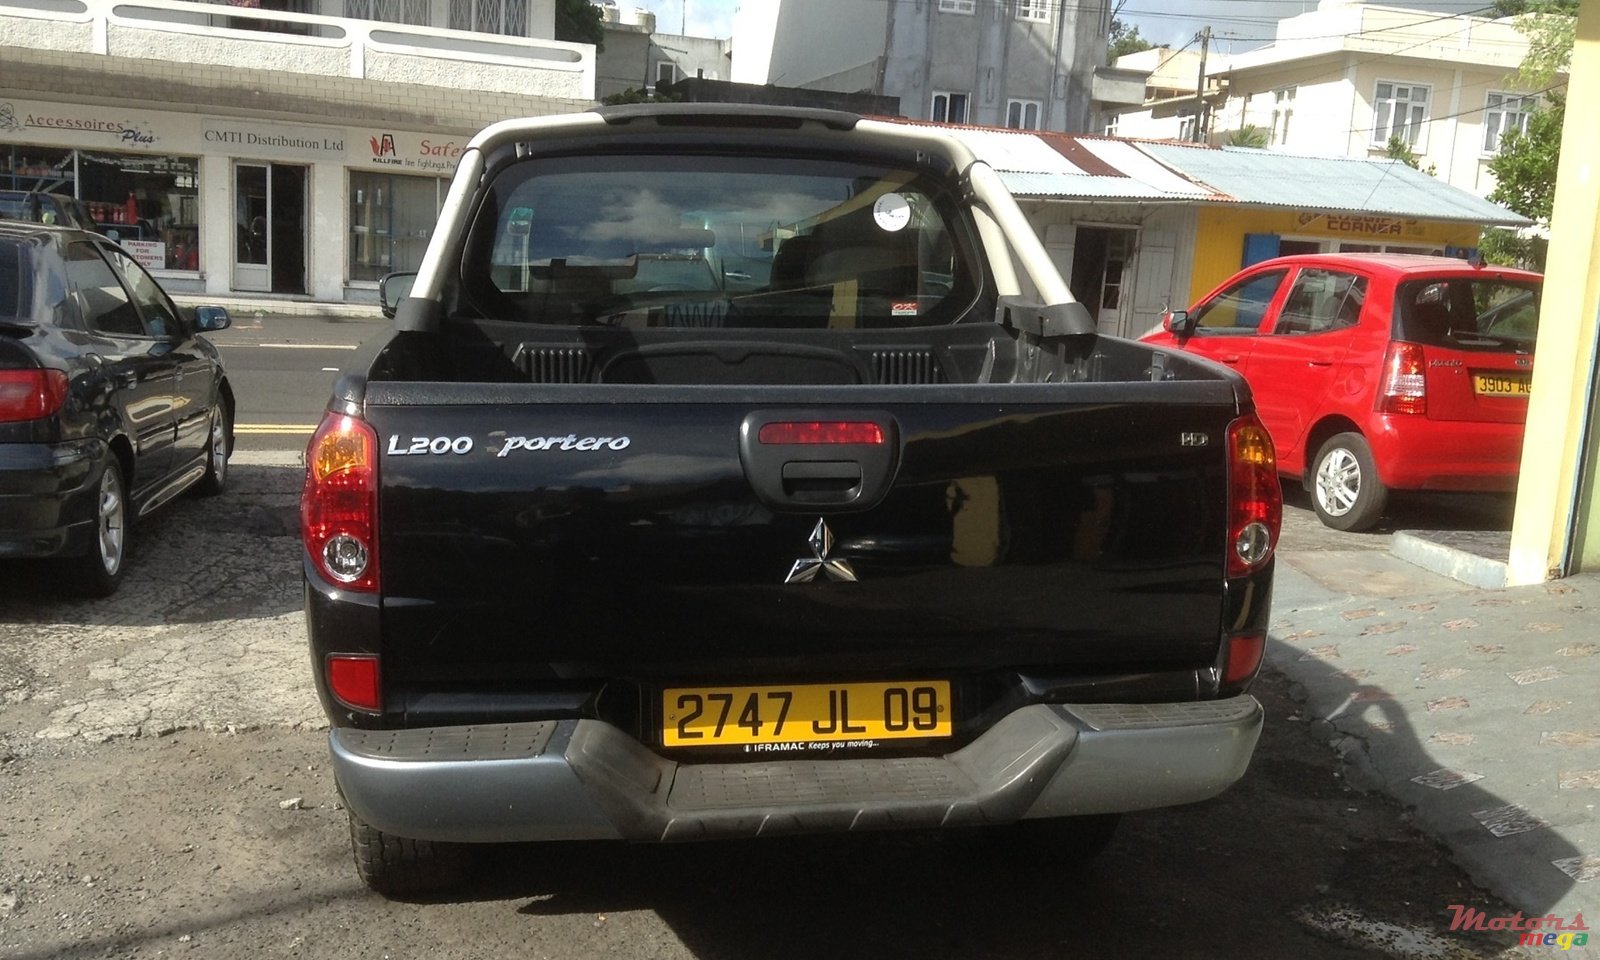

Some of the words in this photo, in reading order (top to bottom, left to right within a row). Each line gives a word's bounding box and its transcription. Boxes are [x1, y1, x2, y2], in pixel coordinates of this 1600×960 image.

[25, 114, 124, 131] Accessoires
[121, 129, 154, 143] Plus
[204, 129, 242, 144] CMTI
[247, 132, 320, 150] Distribution
[324, 138, 344, 151] Ltd
[420, 140, 464, 157] Safe
[1327, 220, 1402, 234] CORNER
[1480, 376, 1512, 393] 3903
[388, 435, 474, 456] L200
[677, 691, 793, 739] 2747
[812, 690, 866, 734] JL
[884, 686, 937, 732] 09
[754, 742, 805, 752] IFRAMAC
[808, 741, 830, 750] Keeps
[832, 741, 845, 749] you
